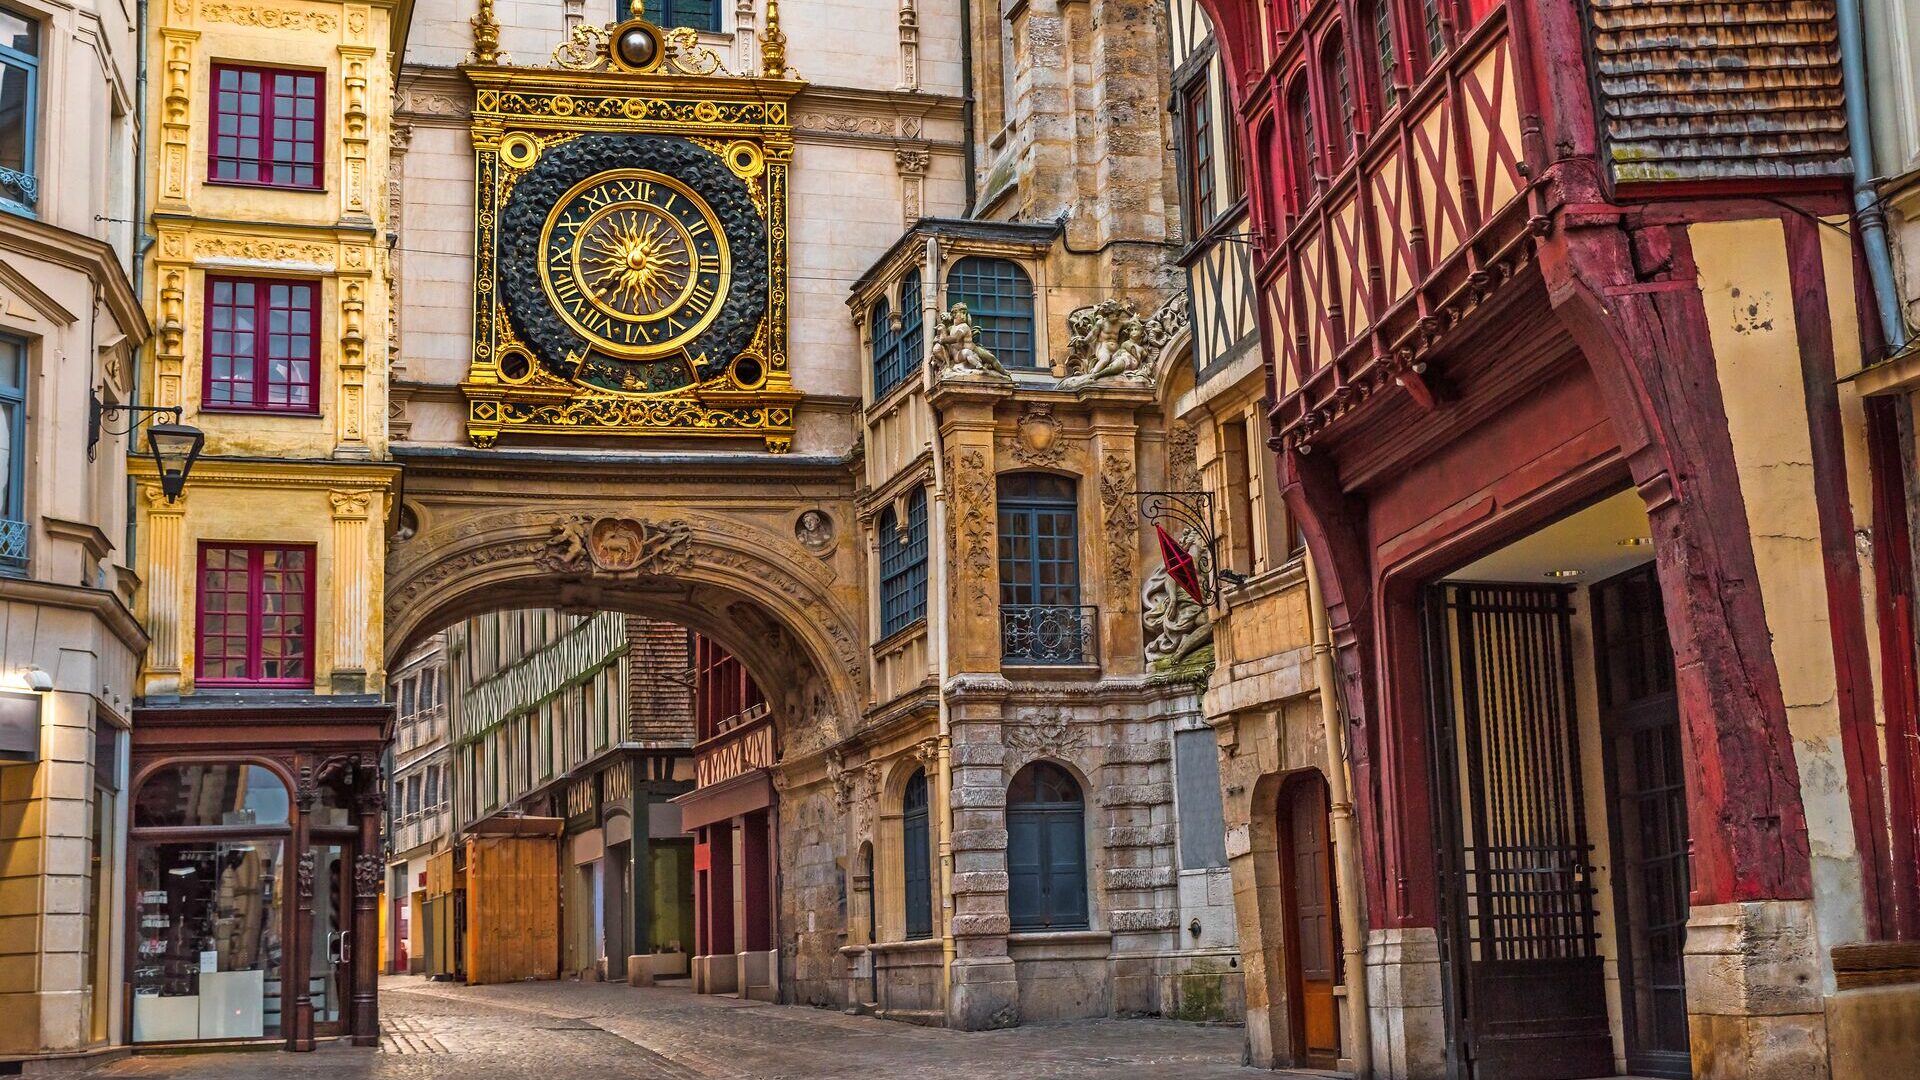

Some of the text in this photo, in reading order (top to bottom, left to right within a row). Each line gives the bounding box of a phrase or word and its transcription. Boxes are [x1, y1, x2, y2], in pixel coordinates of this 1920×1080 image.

[581, 186, 612, 212] XI
[616, 181, 651, 201] XII
[665, 193, 677, 209] I
[558, 211, 583, 235] X
[688, 219, 709, 237] II
[551, 246, 571, 271] IX
[700, 255, 718, 273] III
[554, 277, 582, 316] VIII
[687, 285, 714, 315] IIII
[583, 309, 612, 338] VII
[625, 323, 652, 343] VI
[668, 317, 686, 337] V
